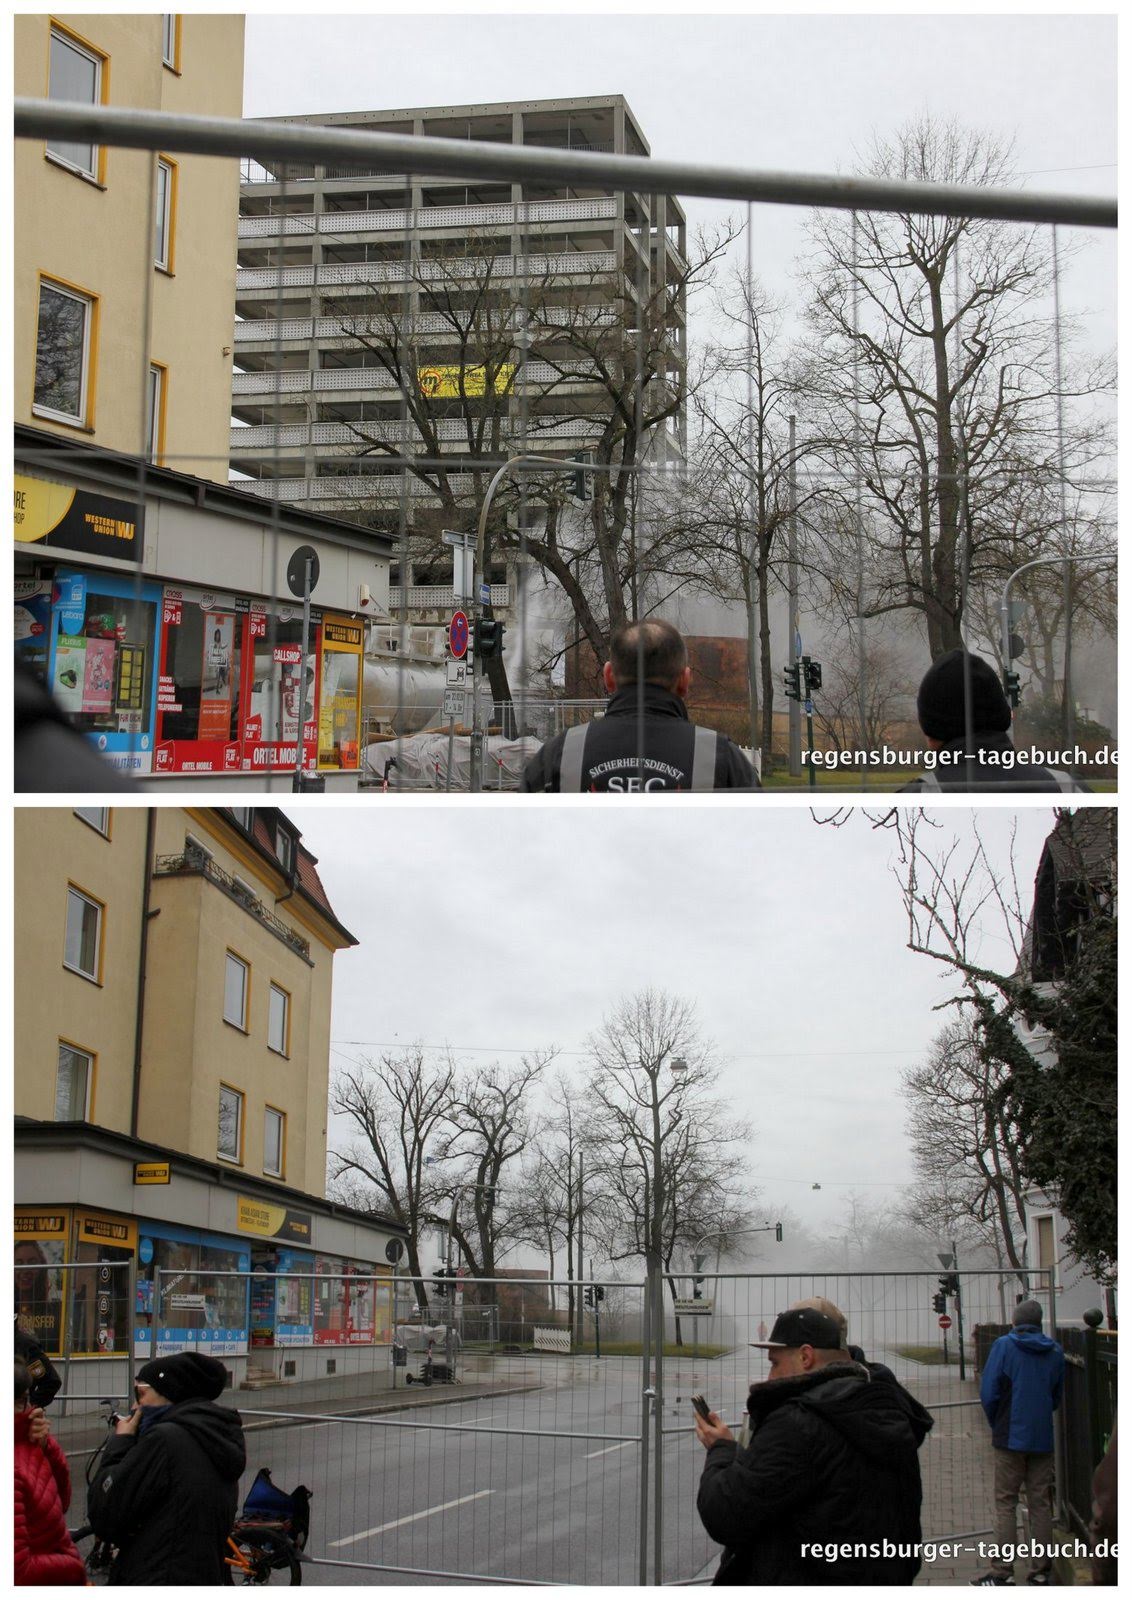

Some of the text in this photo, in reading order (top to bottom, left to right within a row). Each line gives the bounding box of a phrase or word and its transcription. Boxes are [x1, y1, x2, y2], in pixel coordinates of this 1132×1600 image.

[85, 513, 116, 528] WESTERN
[93, 524, 115, 536] UNION
[116, 520, 136, 540] WU
[326, 624, 347, 634] WESTERN
[273, 648, 300, 663] CALLSHOP
[253, 747, 279, 765] ORTEL
[279, 747, 308, 764] MOBE
[182, 761, 213, 770] ORTEL MOBILE
[38, 1217, 61, 1231] WU
